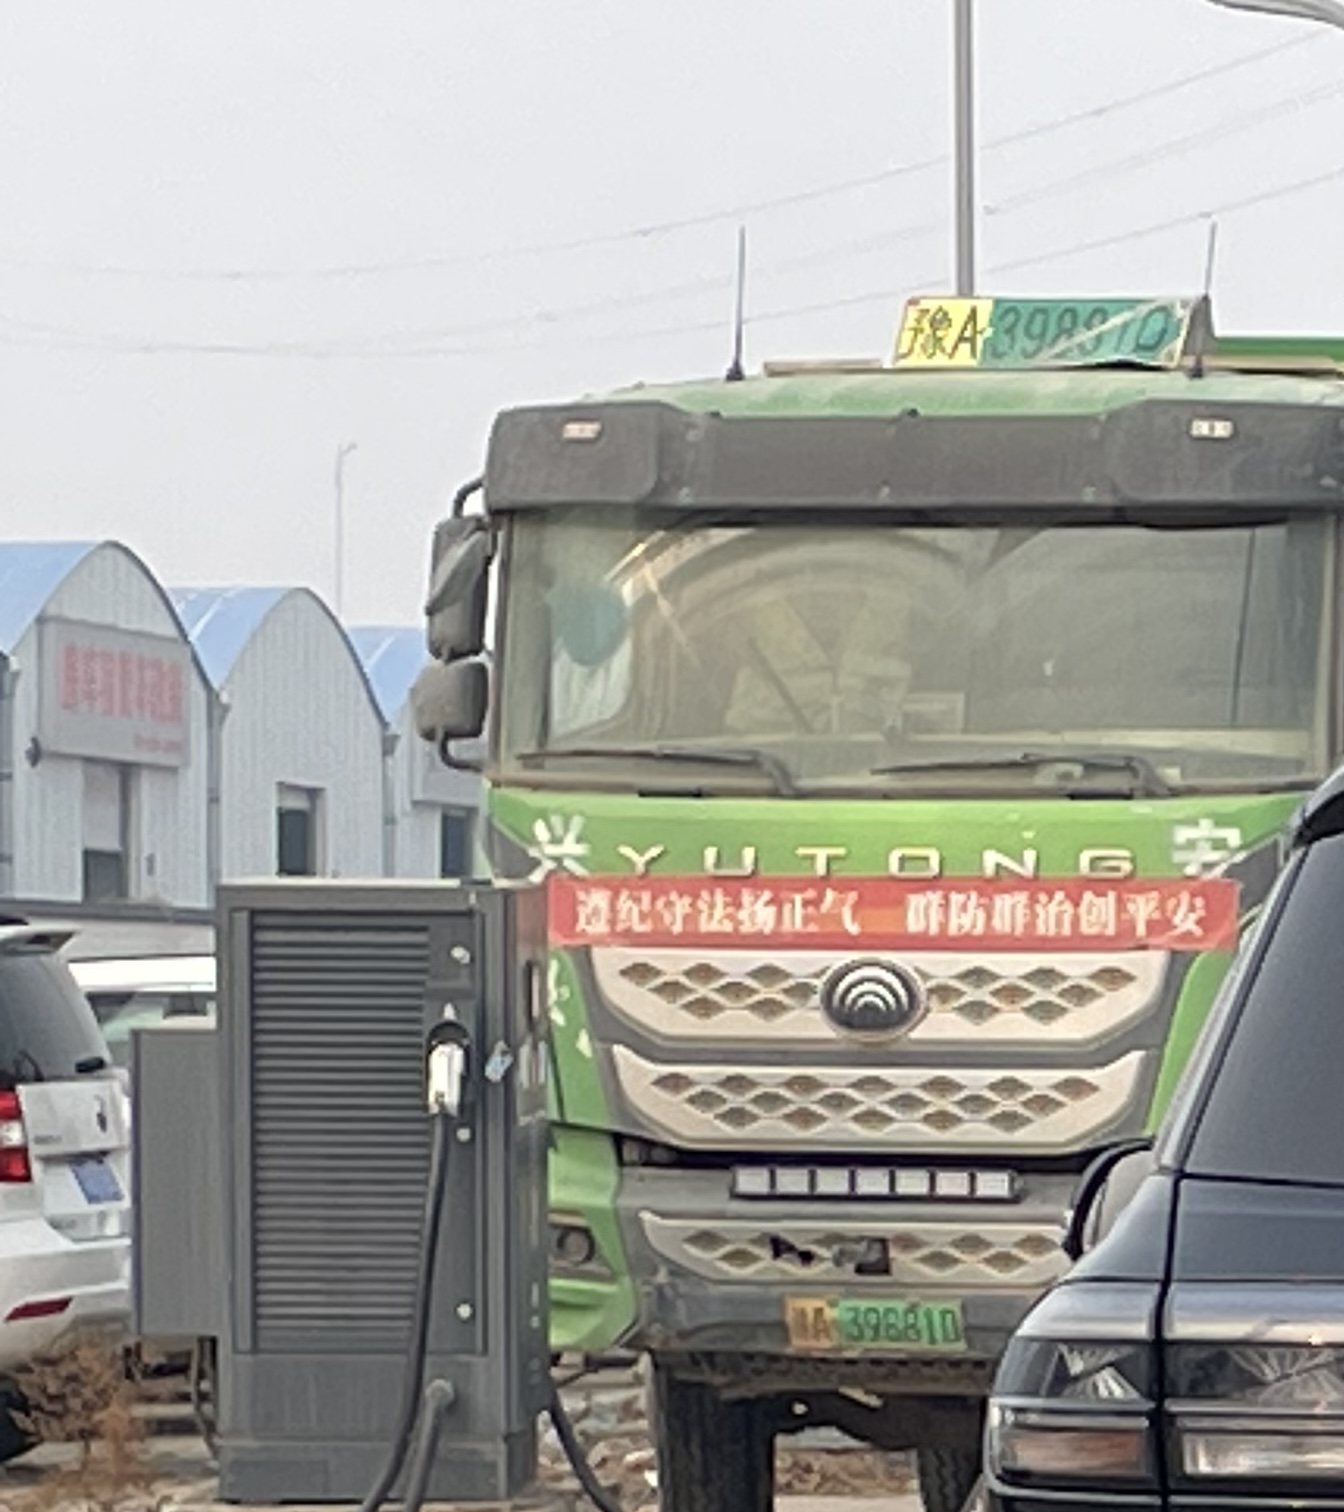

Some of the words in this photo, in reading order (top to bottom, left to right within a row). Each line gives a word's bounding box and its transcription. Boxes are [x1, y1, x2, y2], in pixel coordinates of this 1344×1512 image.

[617, 846, 1134, 880] YUTONG
[576, 887, 861, 935] 遵纪守法扬正气
[906, 889, 1206, 937] 群防群治创平安
